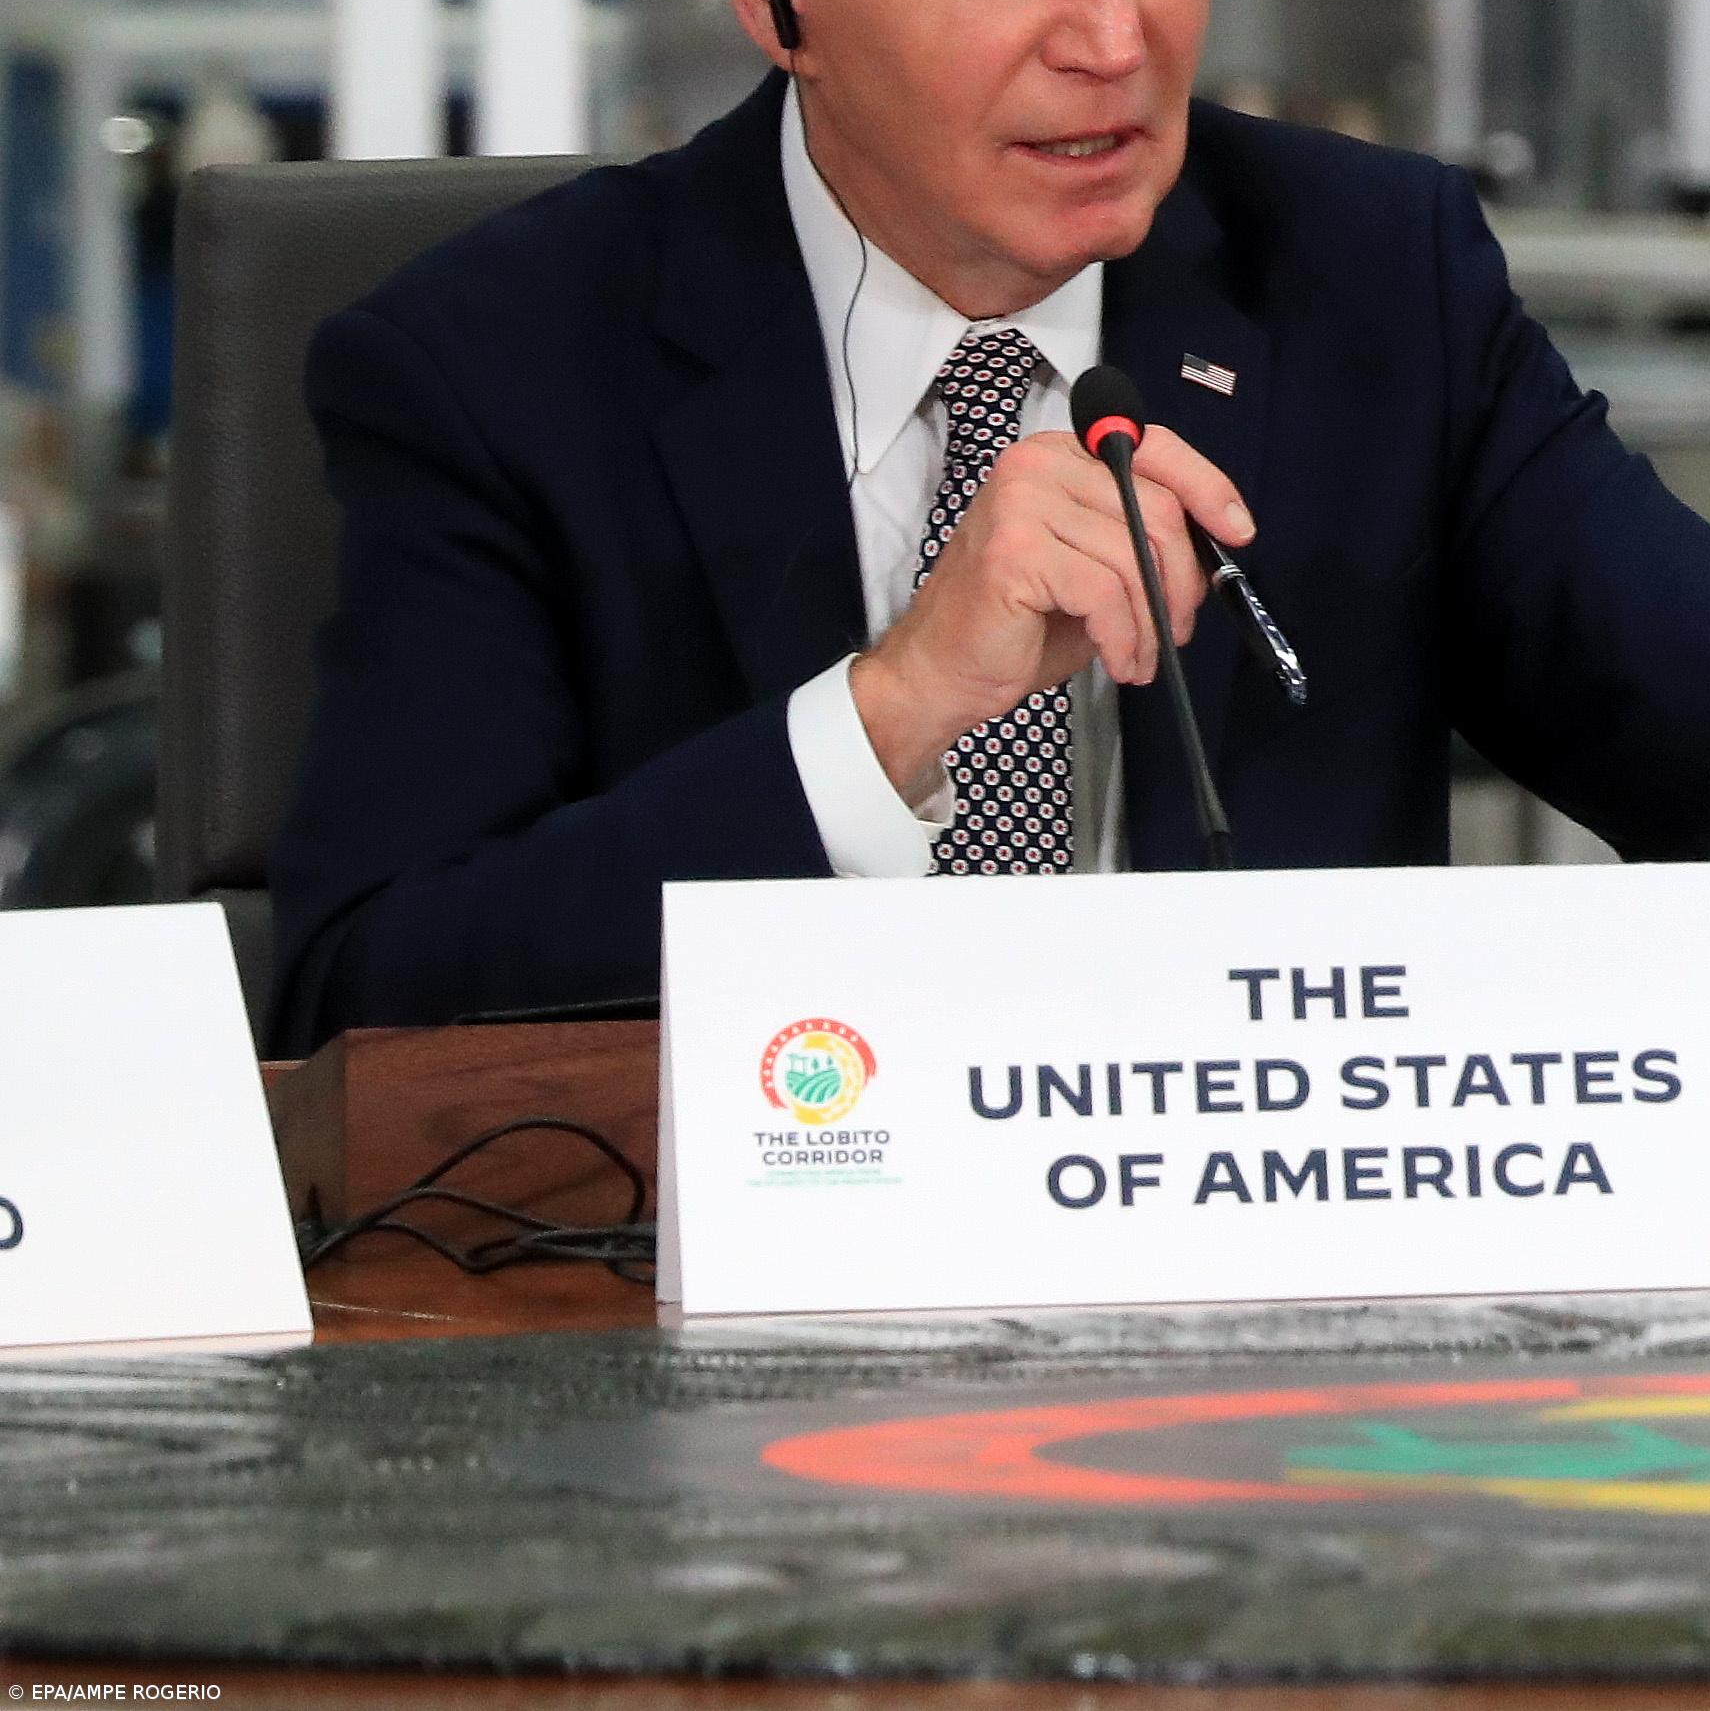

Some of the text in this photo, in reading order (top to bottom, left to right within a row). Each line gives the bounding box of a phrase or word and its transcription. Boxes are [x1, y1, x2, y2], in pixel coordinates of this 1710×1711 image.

[1229, 966, 1411, 1022] THE
[969, 1050, 1683, 1122] UNITED STATES
[755, 1130, 890, 1146] THE LOBITO
[763, 1149, 883, 1165] CORRIDOR
[1047, 1143, 1614, 1211] OF AMERICA
